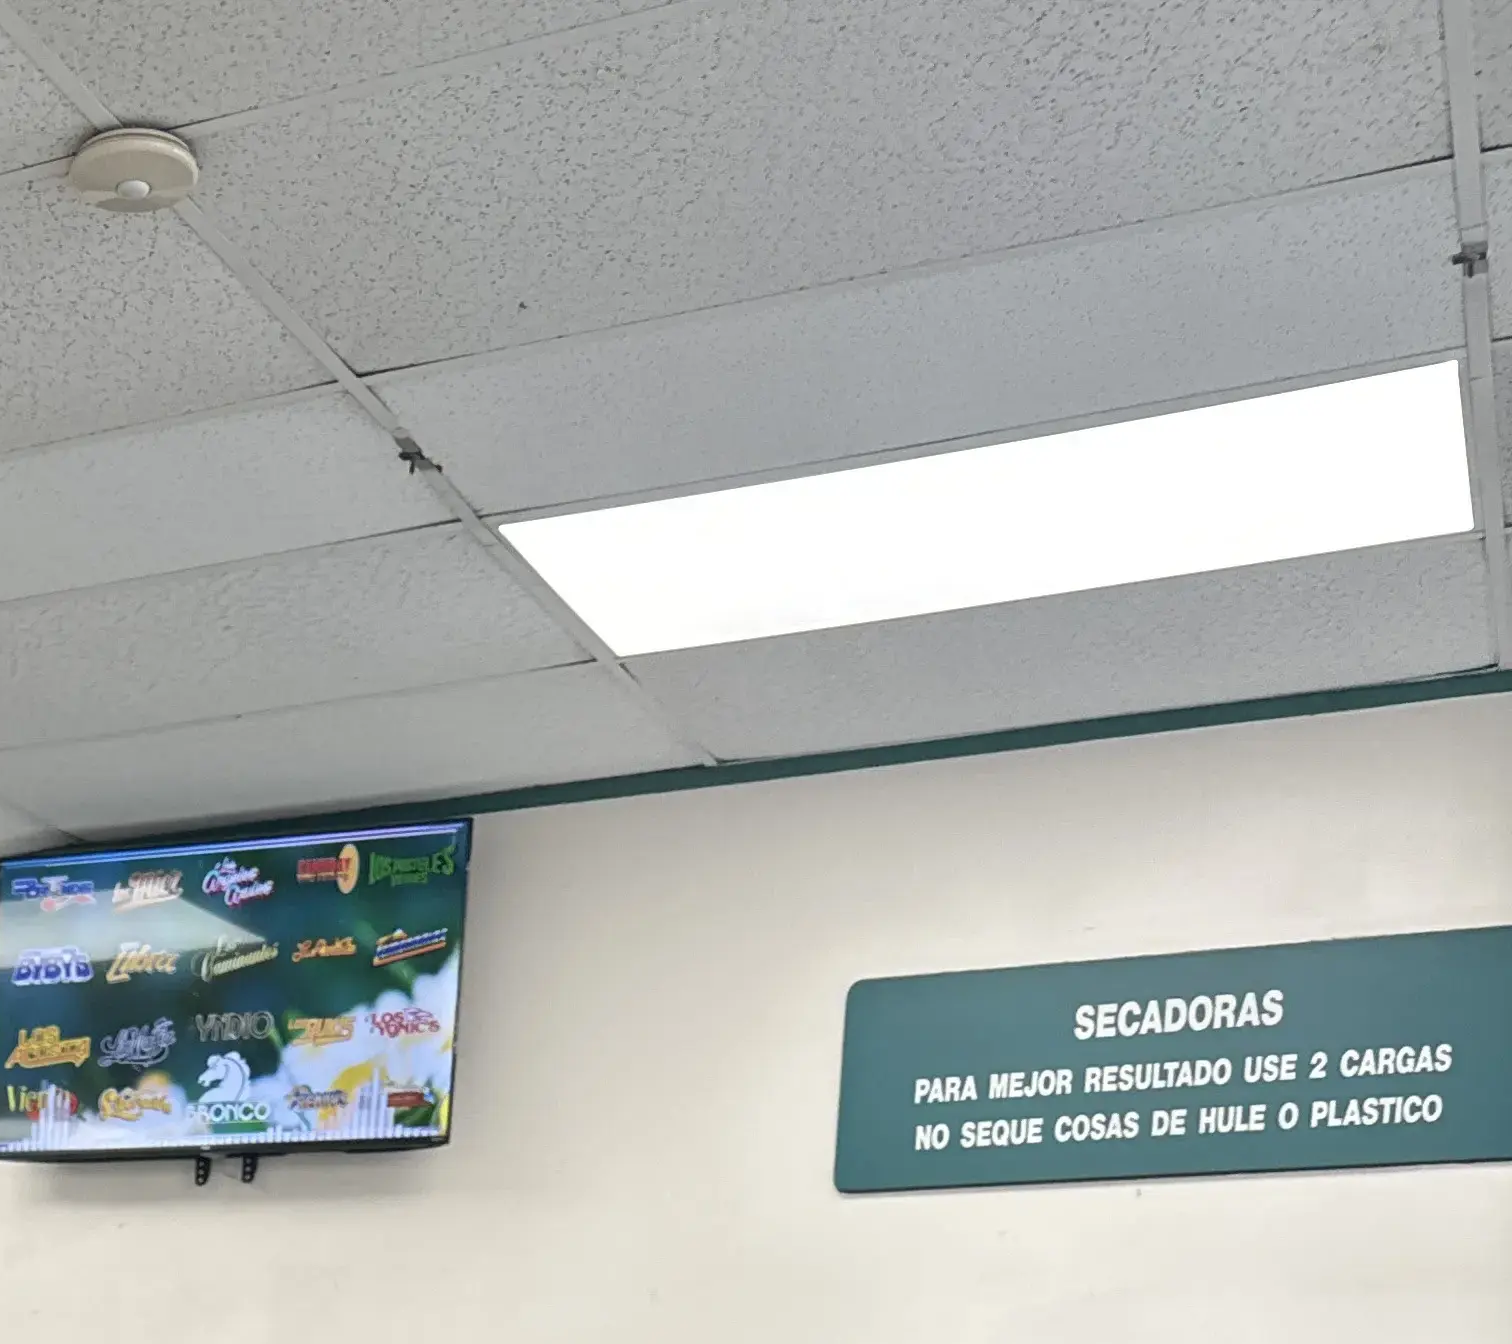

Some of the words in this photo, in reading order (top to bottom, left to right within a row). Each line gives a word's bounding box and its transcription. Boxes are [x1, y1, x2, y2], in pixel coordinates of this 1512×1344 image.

[1074, 989, 1284, 1040] SECADORAS
[914, 1075, 978, 1104] PARA
[989, 1067, 1072, 1100] MEJOR
[1084, 1057, 1232, 1094] RESULTADO
[1244, 1054, 1297, 1083] USE
[1309, 1052, 1328, 1079] 2
[1340, 1043, 1453, 1078] CARGAS
[914, 1123, 950, 1151] NO
[960, 1117, 1043, 1148] SEQUE
[1054, 1113, 1140, 1142] COSAS
[1151, 1110, 1186, 1137] DE
[1198, 1105, 1266, 1133] HULE
[1278, 1102, 1300, 1130] O
[1310, 1094, 1444, 1128] PLASTICO
